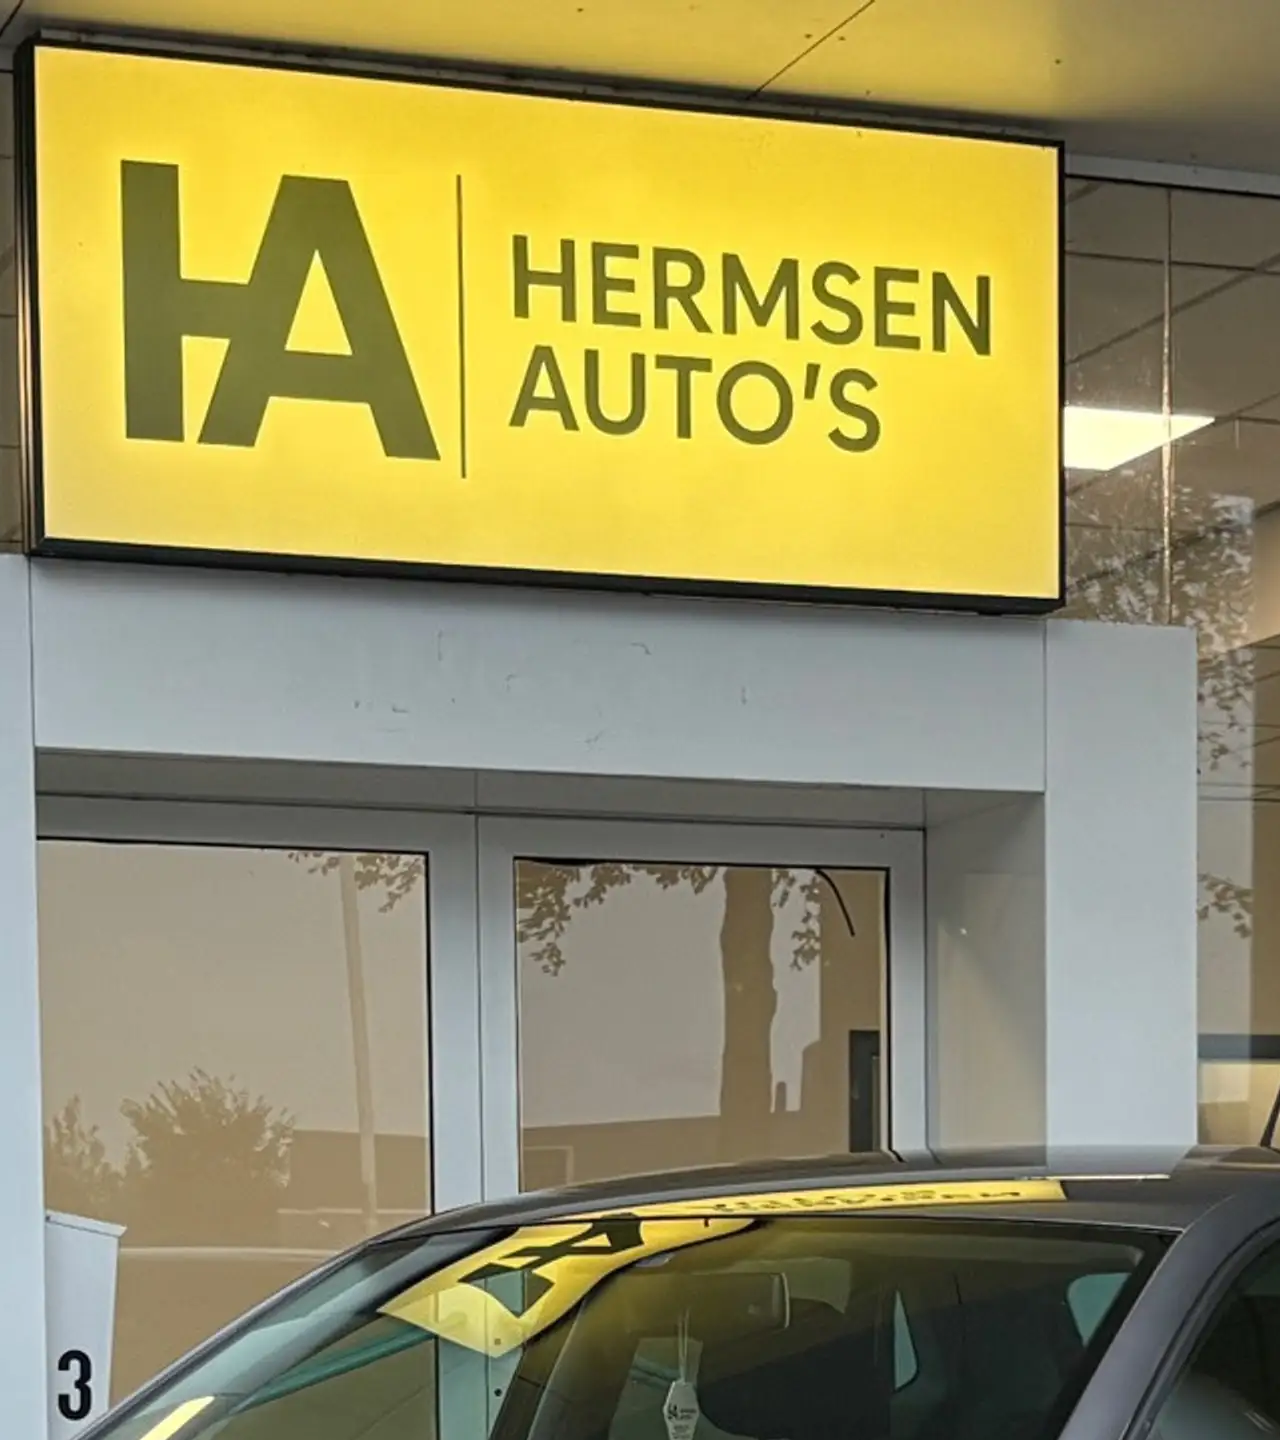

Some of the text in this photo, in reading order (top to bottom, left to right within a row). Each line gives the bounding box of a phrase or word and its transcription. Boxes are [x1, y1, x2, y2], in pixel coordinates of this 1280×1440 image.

[511, 234, 992, 356] HERMSEN
[508, 344, 881, 453] AUTO'S
[57, 1349, 92, 1421] 3
